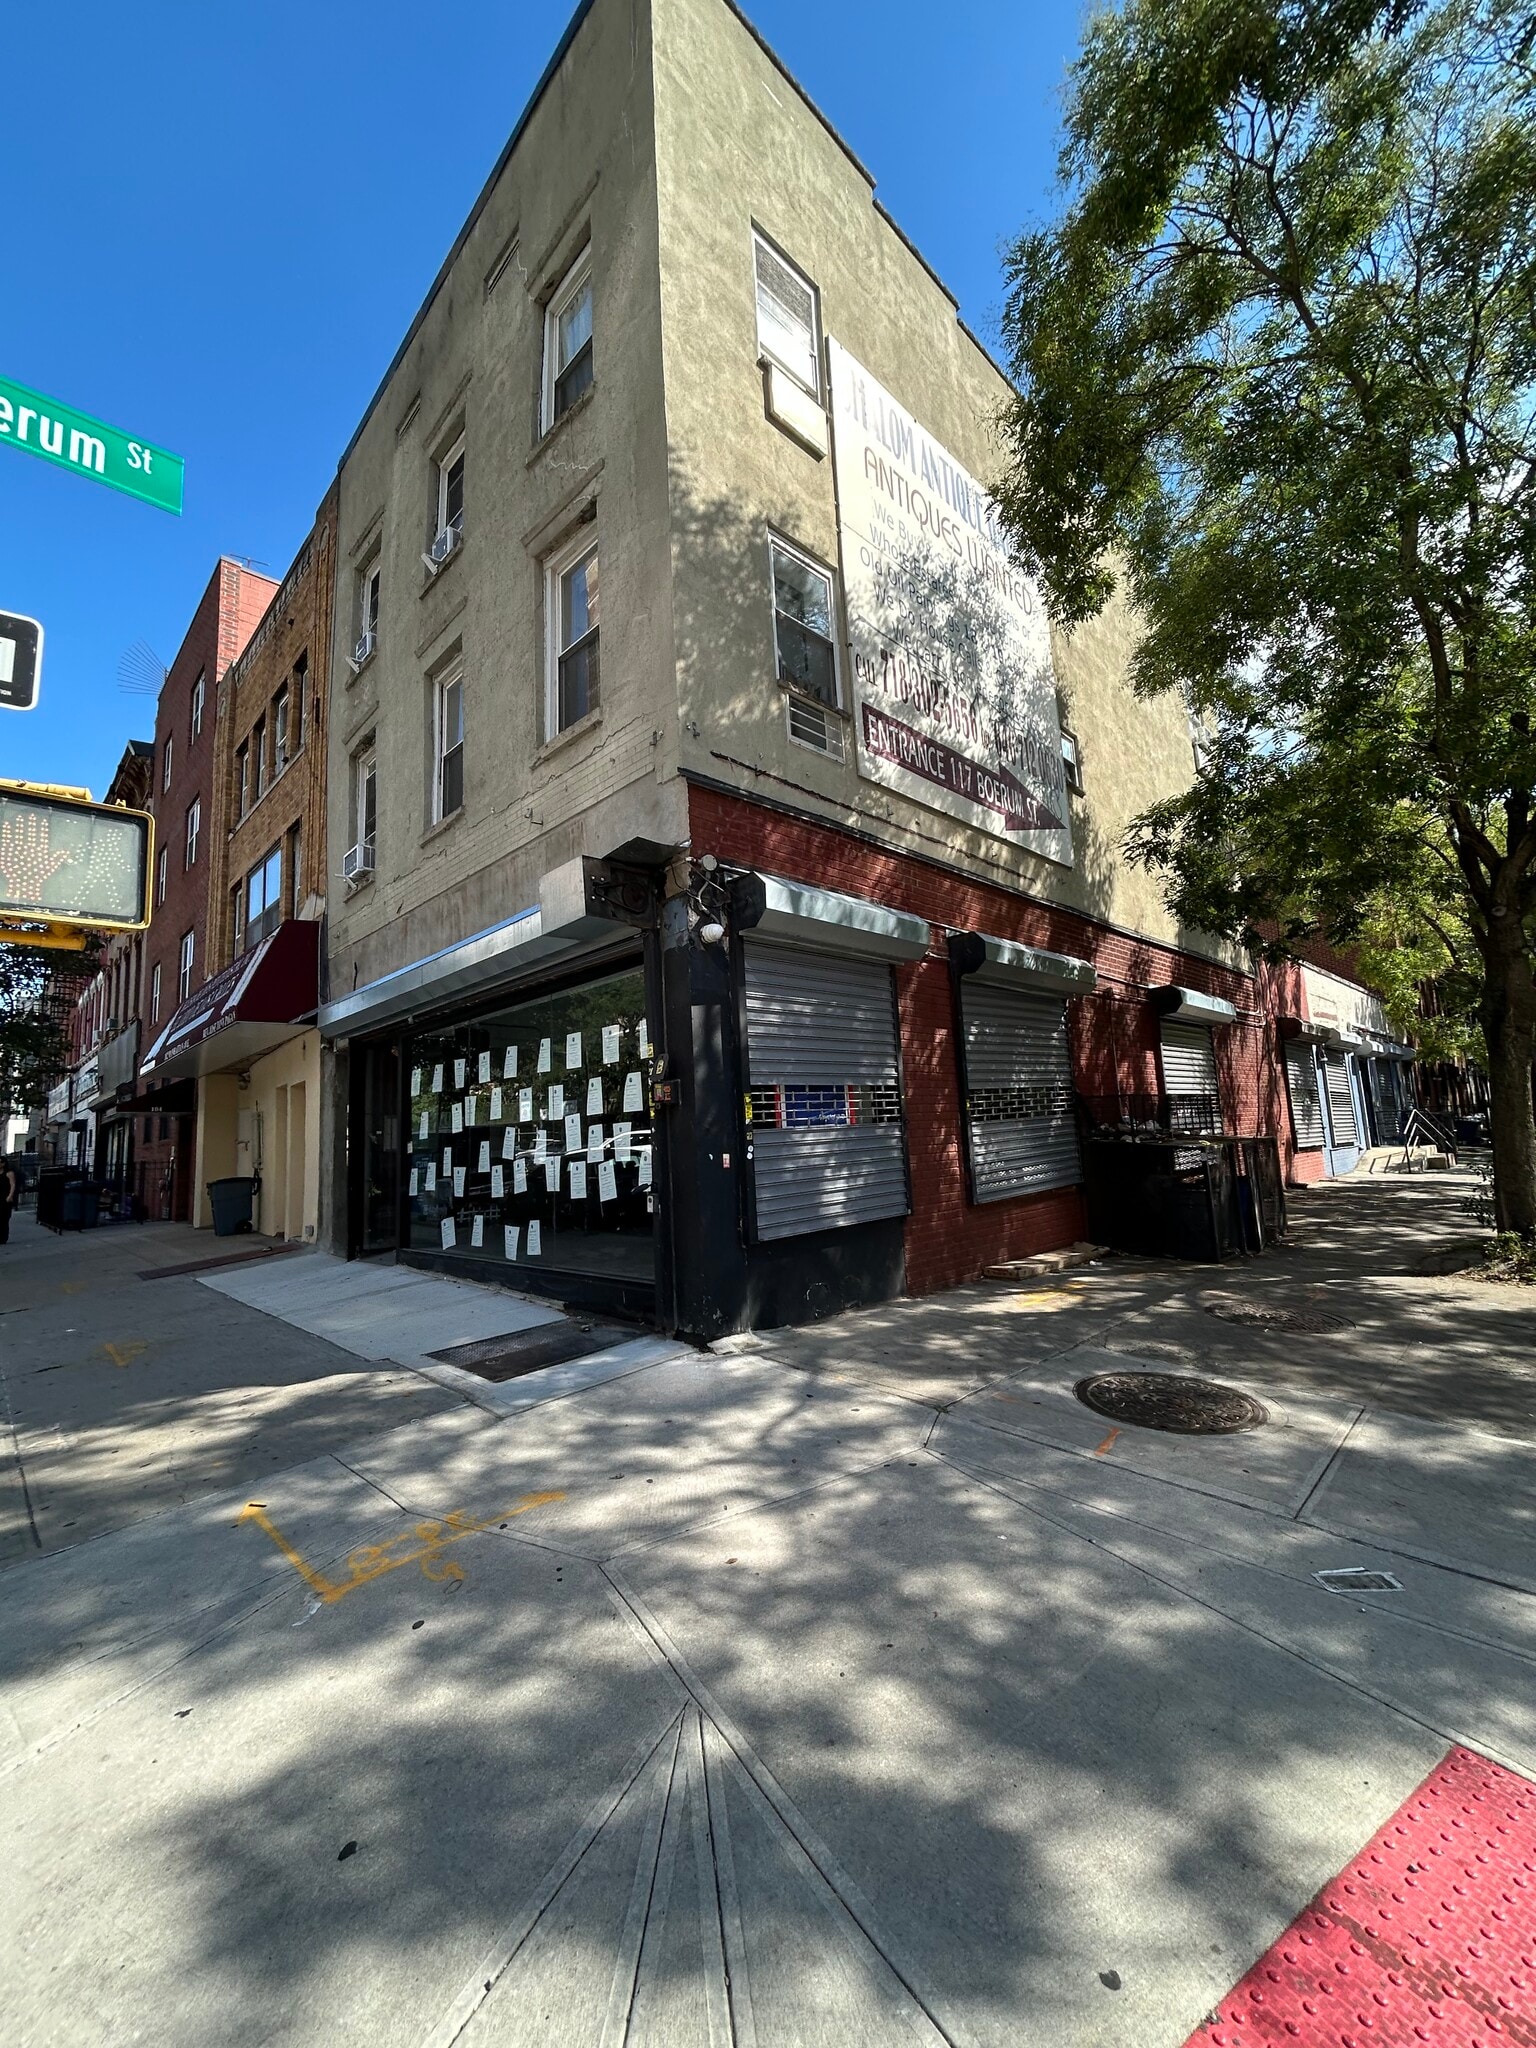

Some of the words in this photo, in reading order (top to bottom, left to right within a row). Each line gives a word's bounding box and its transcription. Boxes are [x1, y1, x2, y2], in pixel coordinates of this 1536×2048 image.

[126, 441, 153, 474] St
[917, 434, 985, 539] ANTIQUE
[862, 442, 963, 563] ANTIQUES
[966, 534, 1033, 620] WANTED
[869, 522, 909, 569] Whole
[913, 556, 954, 603] Estates
[873, 499, 894, 532] We
[860, 543, 882, 578] Old
[887, 564, 904, 593] Oil
[908, 579, 960, 637] Paintgs
[872, 580, 894, 612] We
[898, 598, 915, 626] Do
[919, 613, 954, 653] House
[958, 640, 982, 672] Calls
[854, 651, 877, 687] CALL
[879, 645, 978, 745] 718-302-5656
[867, 712, 945, 780] ENTRANCE
[950, 756, 972, 793] 117
[976, 769, 1024, 819] BOERUM
[1026, 795, 1040, 827] ST.
